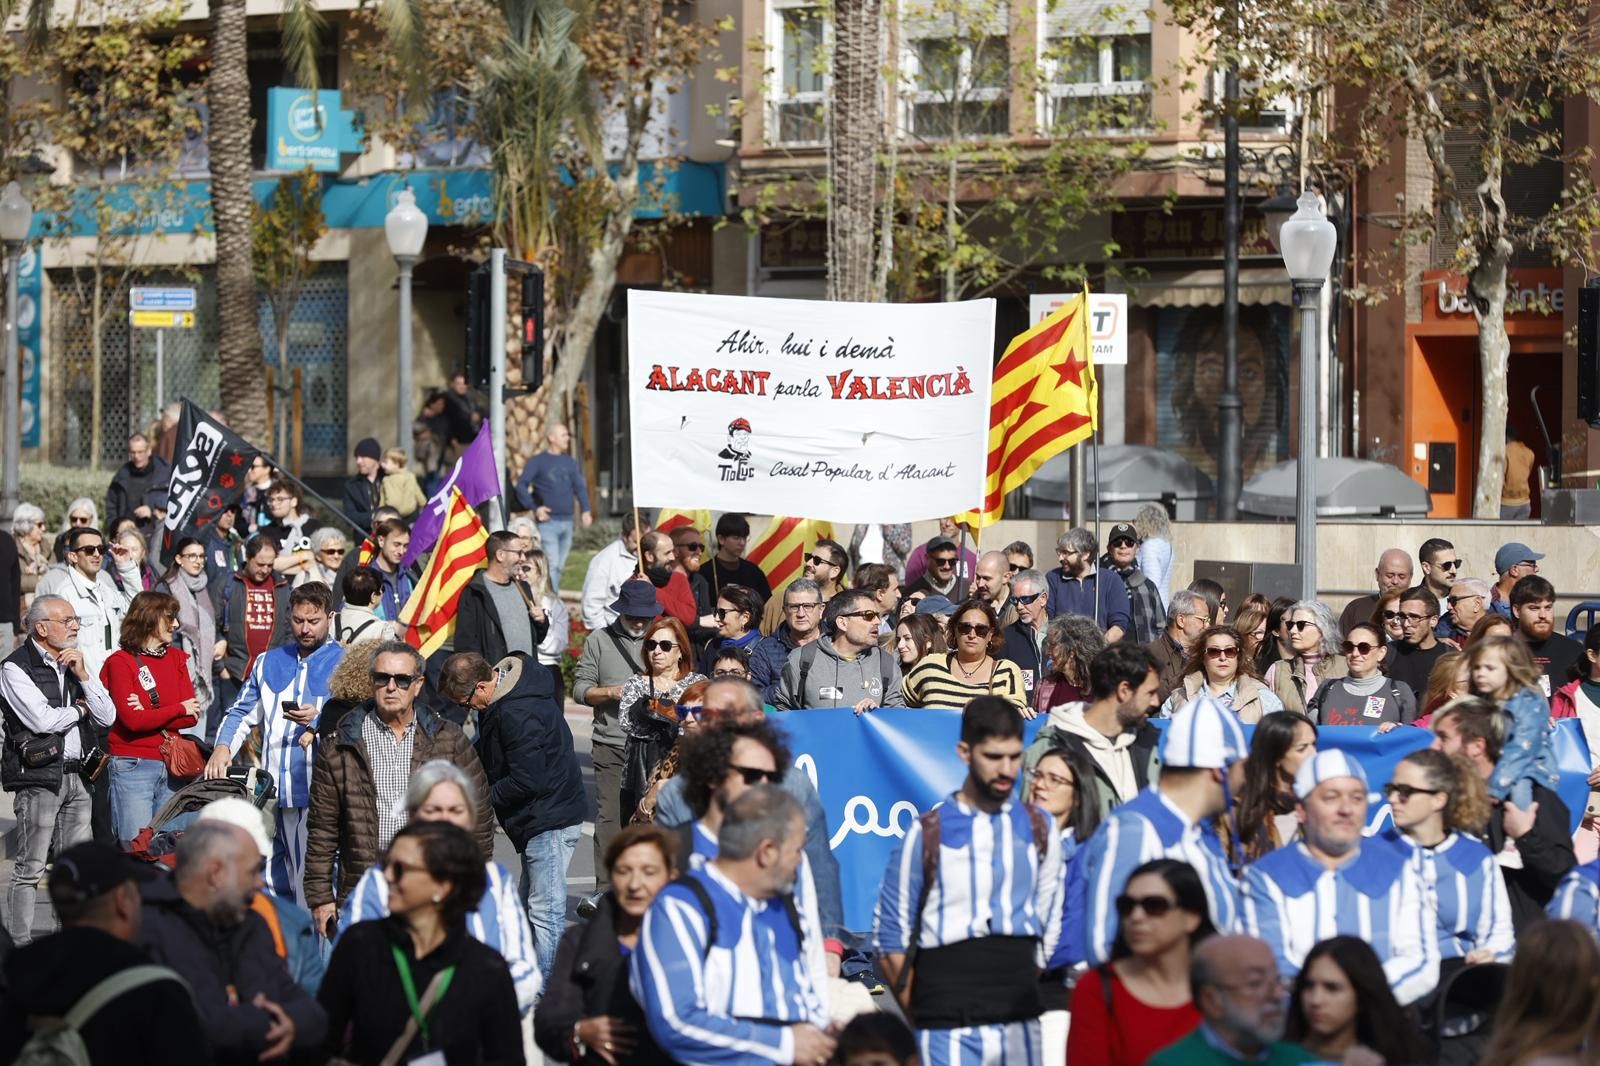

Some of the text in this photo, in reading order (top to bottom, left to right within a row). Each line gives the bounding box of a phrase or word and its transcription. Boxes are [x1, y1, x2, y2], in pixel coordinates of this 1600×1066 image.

[780, 332, 813, 356] hui
[819, 340, 828, 358] i
[835, 336, 896, 359] demà
[645, 364, 974, 401] ALACANT parla VALENCIÀ
[769, 461, 810, 478] Casal
[811, 461, 874, 482] Popular
